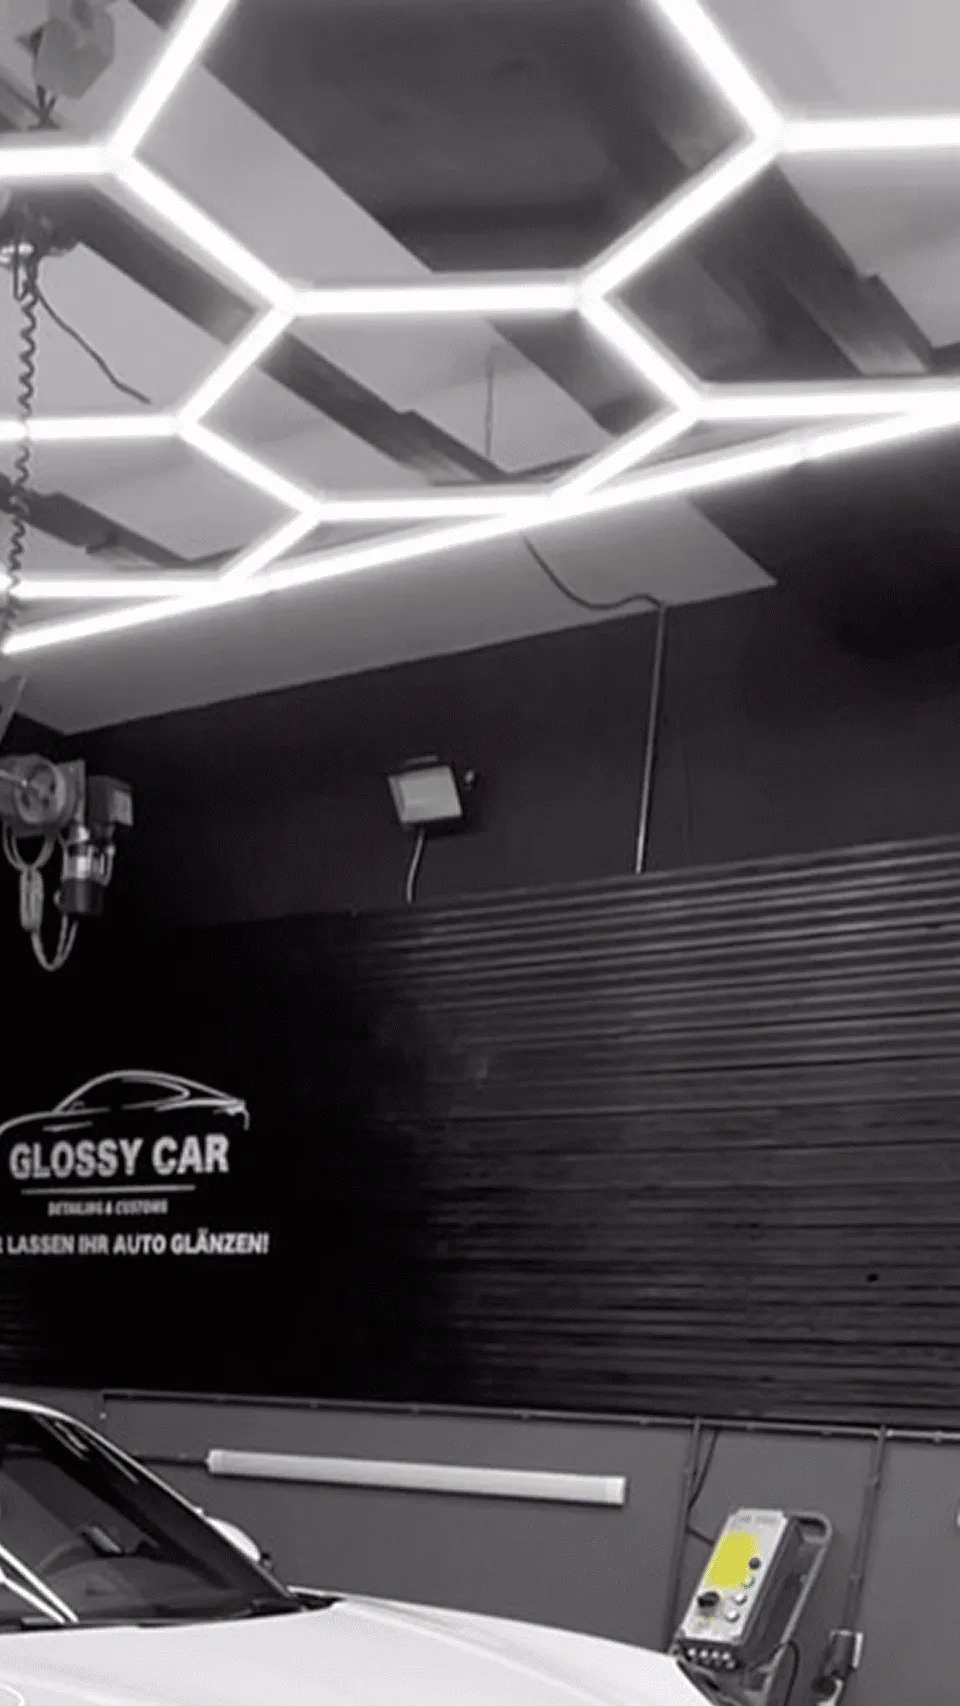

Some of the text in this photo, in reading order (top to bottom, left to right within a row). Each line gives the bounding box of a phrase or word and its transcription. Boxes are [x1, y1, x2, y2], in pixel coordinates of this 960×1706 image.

[9, 1133, 229, 1179] GLOSSY CAR
[7, 1234, 74, 1255] LASSEN
[77, 1234, 109, 1255] IHR
[113, 1233, 167, 1255] AUTO
[170, 1227, 269, 1255] GLÄNZEN!
